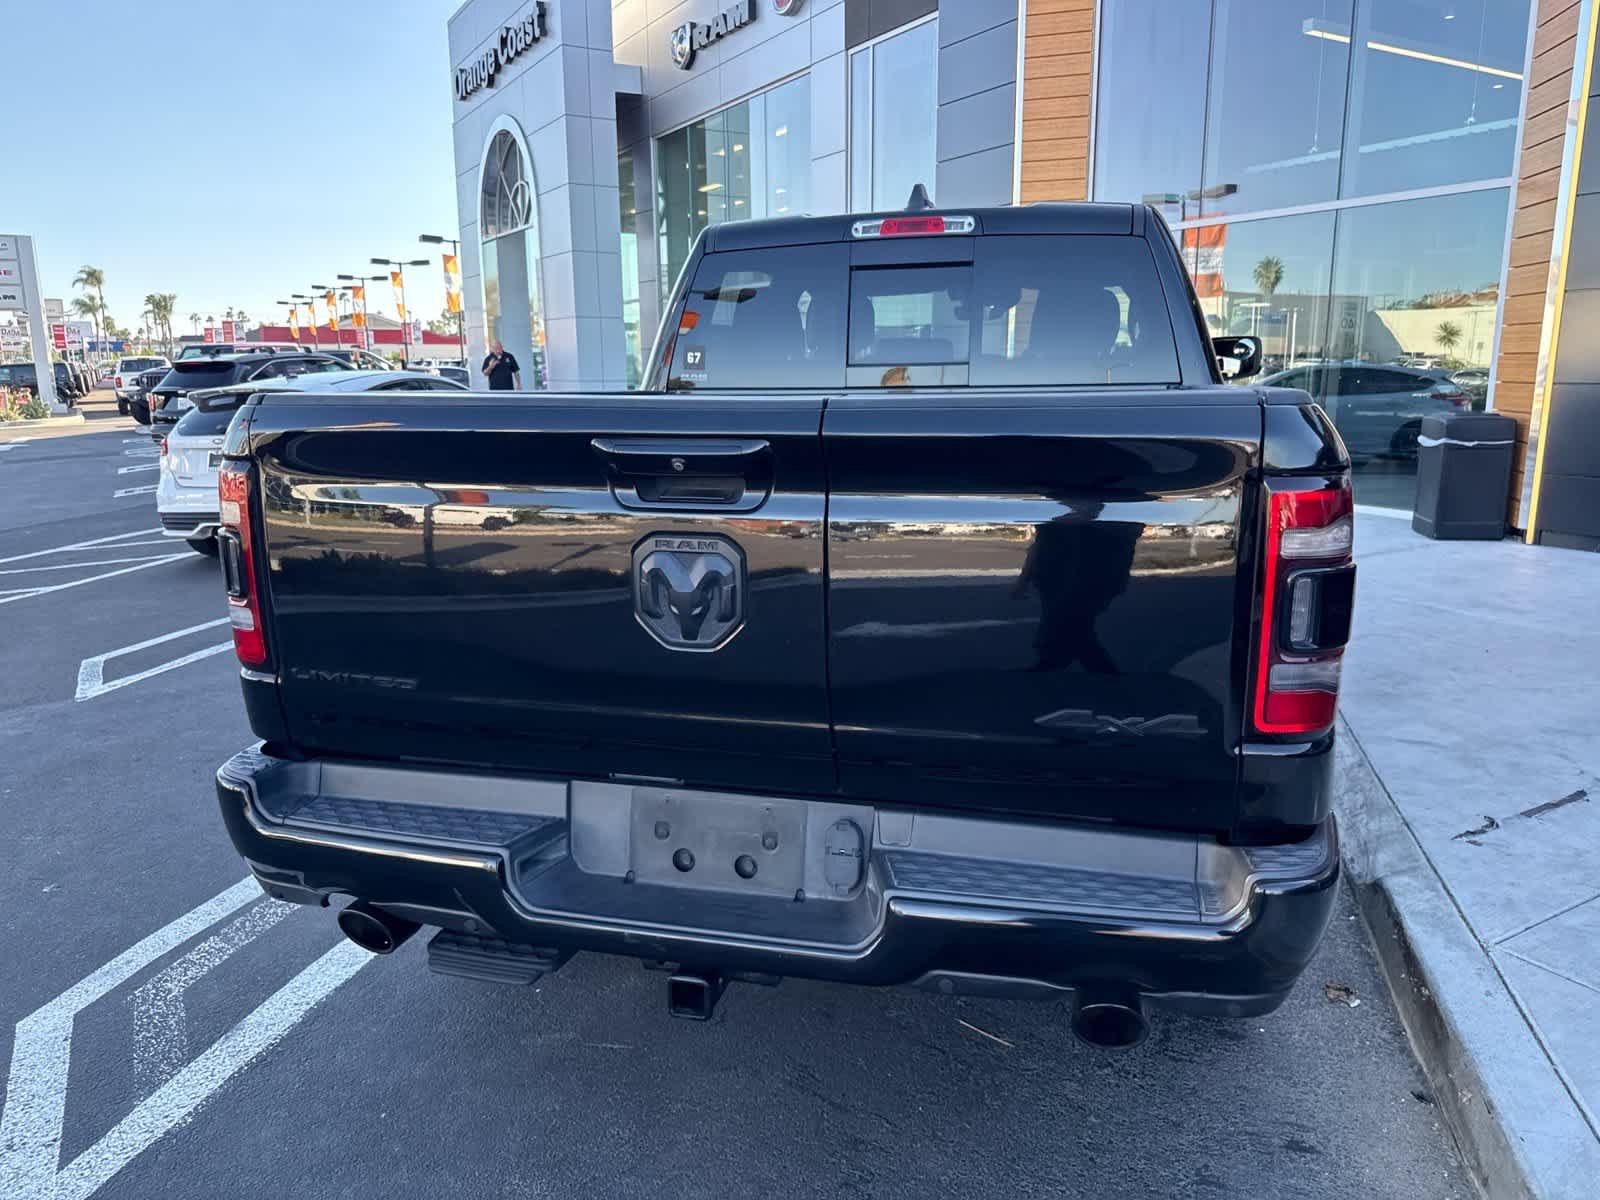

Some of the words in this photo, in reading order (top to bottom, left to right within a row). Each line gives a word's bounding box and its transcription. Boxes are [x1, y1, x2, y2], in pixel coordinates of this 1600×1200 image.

[692, 0, 756, 51] RAM
[455, 47, 500, 101] Orange
[498, 0, 547, 65] Coast
[687, 351, 701, 364] 67
[655, 539, 719, 551] RAM
